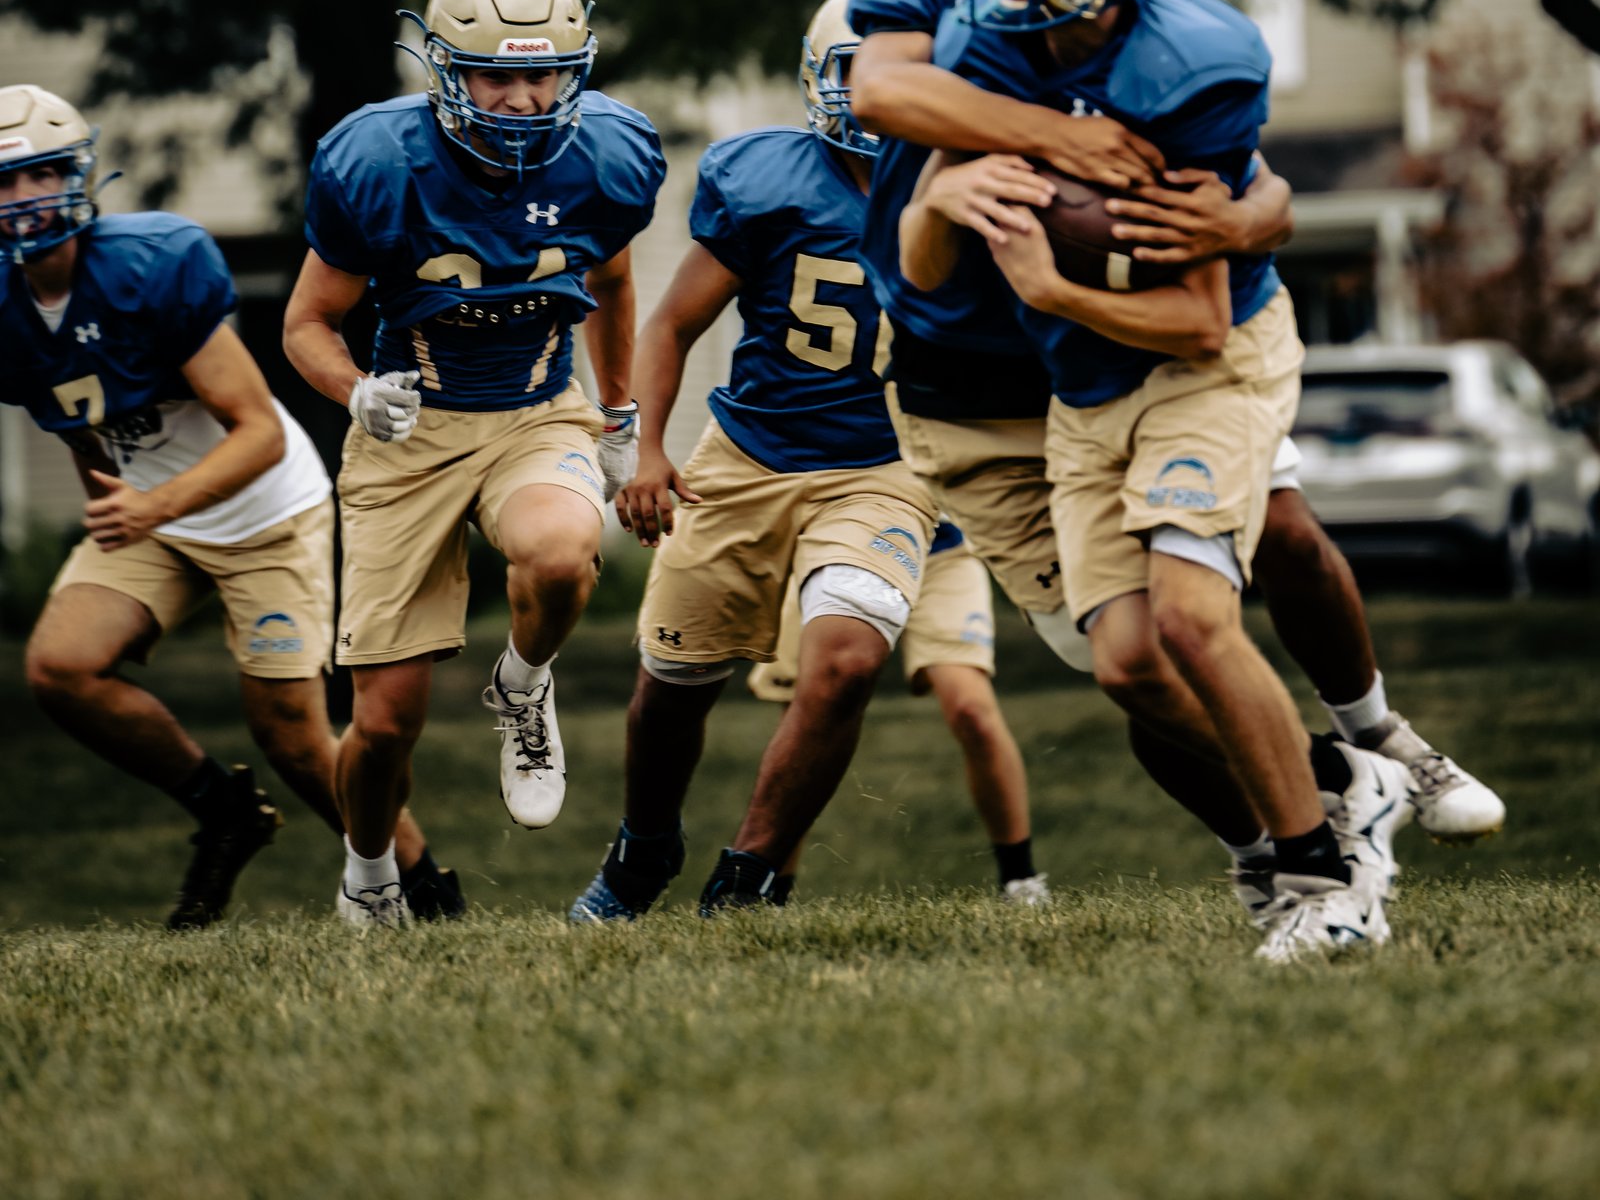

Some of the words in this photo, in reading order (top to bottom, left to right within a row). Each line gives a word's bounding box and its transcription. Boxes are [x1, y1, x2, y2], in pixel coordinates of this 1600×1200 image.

[506, 42, 549, 52] Riddell
[785, 253, 895, 379] 5
[52, 374, 105, 426] 7
[870, 537, 896, 555] HIT
